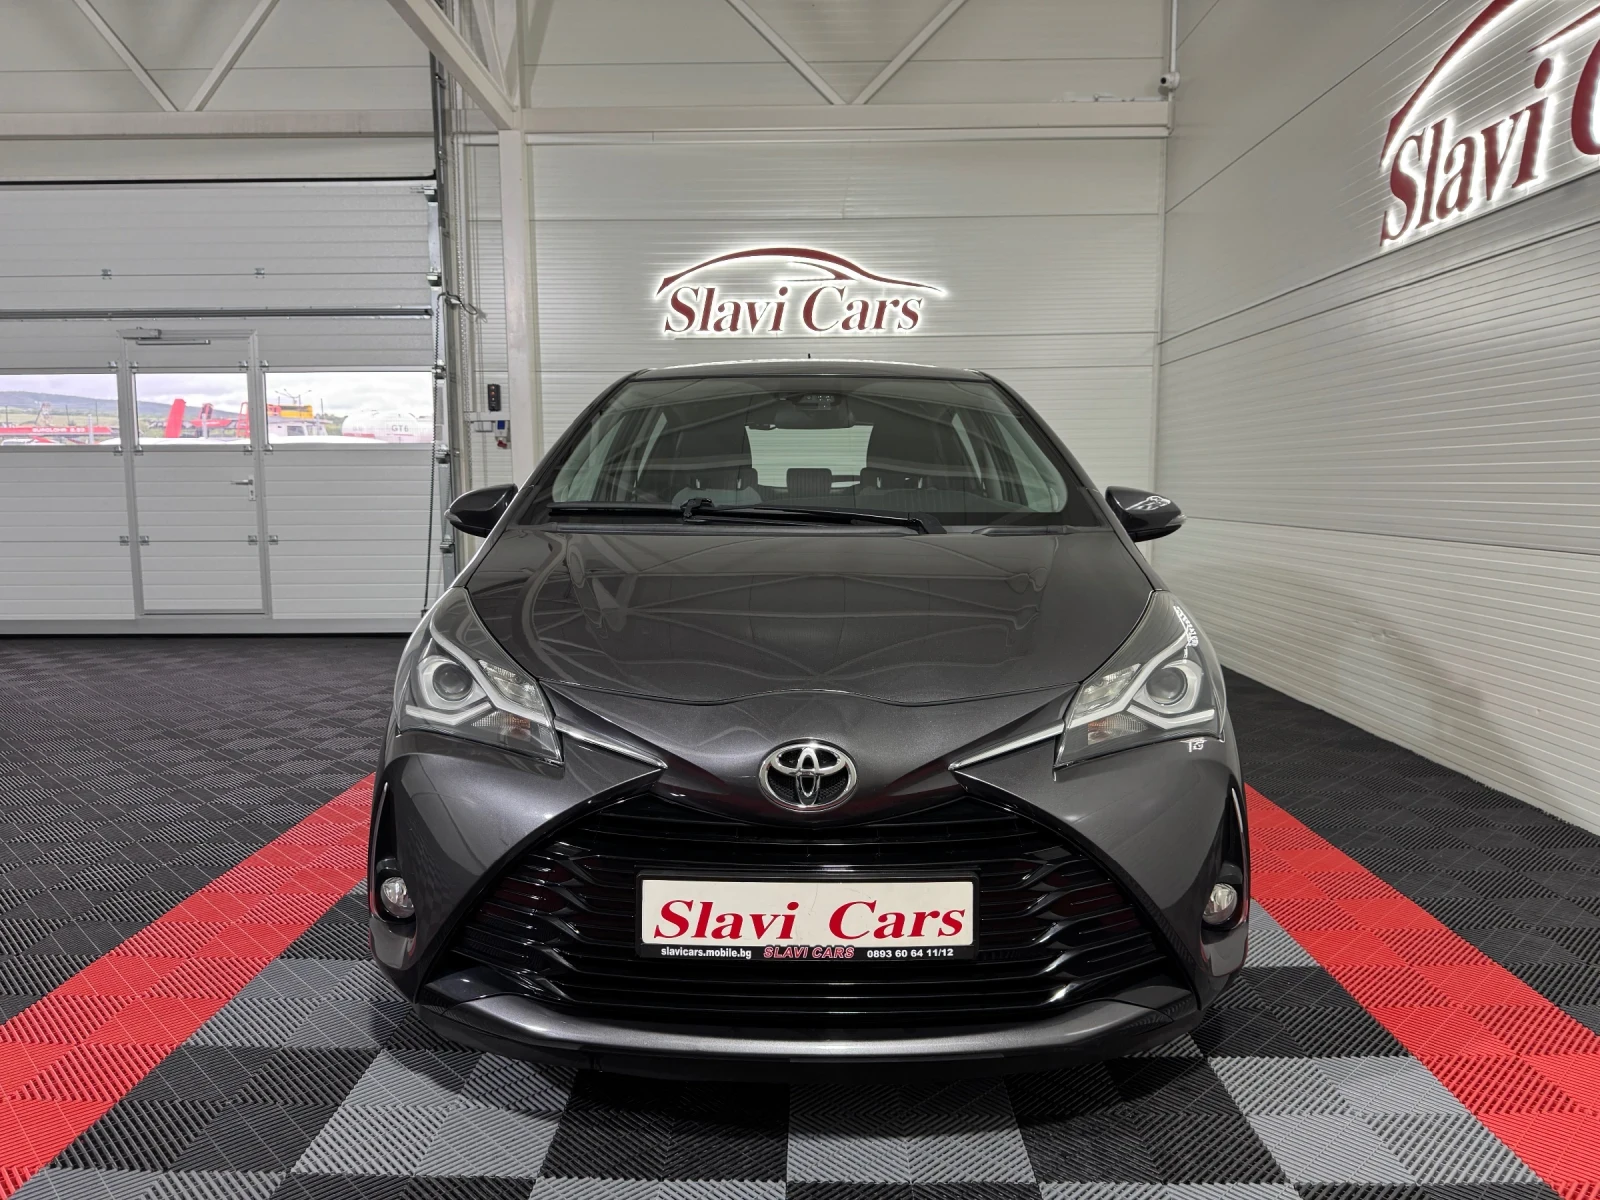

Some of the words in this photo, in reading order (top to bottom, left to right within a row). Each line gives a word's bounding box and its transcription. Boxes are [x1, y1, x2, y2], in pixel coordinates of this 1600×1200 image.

[1379, 57, 1553, 247] Slavi
[664, 286, 788, 333] Slavi
[802, 286, 923, 332] Cars
[653, 899, 800, 940] Slavi
[828, 900, 966, 940] Cars
[660, 946, 752, 960] slavicars.mobile.bg
[763, 946, 809, 958] SLAVI
[811, 946, 855, 959] CARS
[866, 949, 893, 958] 0893
[894, 949, 908, 958] 60
[910, 949, 924, 958] 64
[926, 948, 954, 957] 11/12
